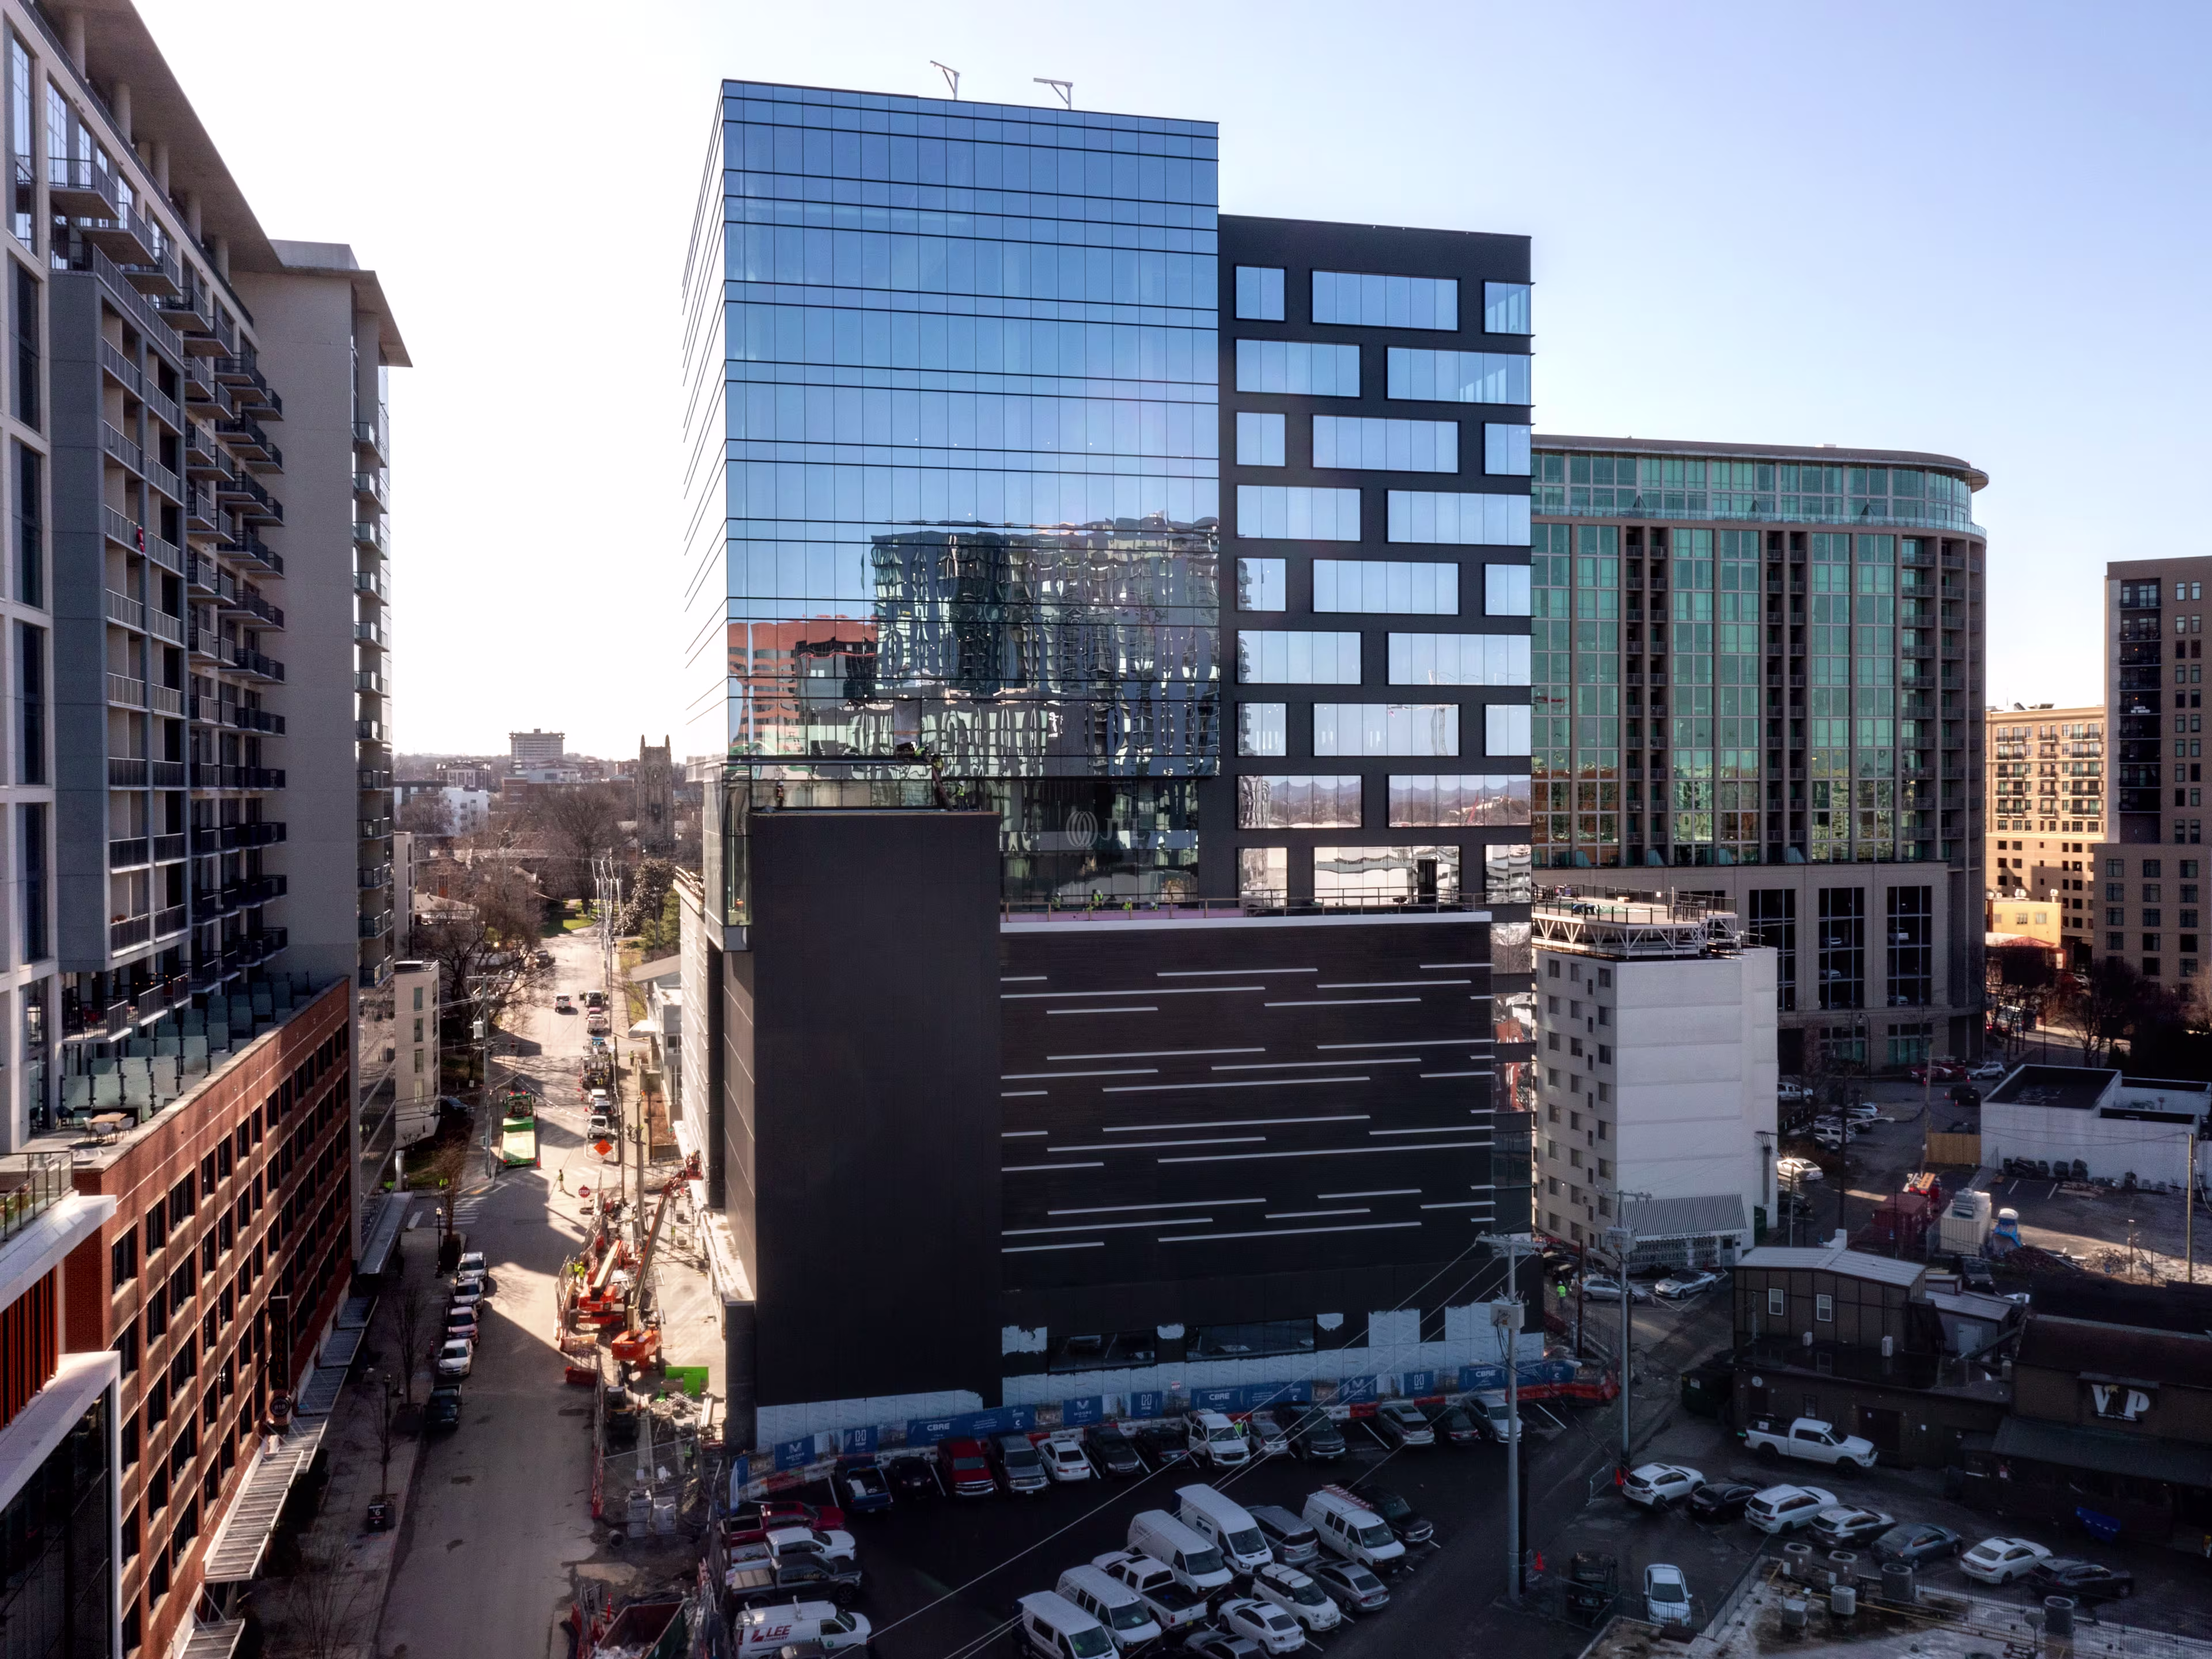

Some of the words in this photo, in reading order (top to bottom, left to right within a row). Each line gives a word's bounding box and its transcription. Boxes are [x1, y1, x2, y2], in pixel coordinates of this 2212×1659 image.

[274, 1317, 285, 1385] MORRIS
[1209, 1392, 1230, 1400] CBRE
[927, 1423, 950, 1431] CBRE
[766, 1625, 792, 1637] LEE
